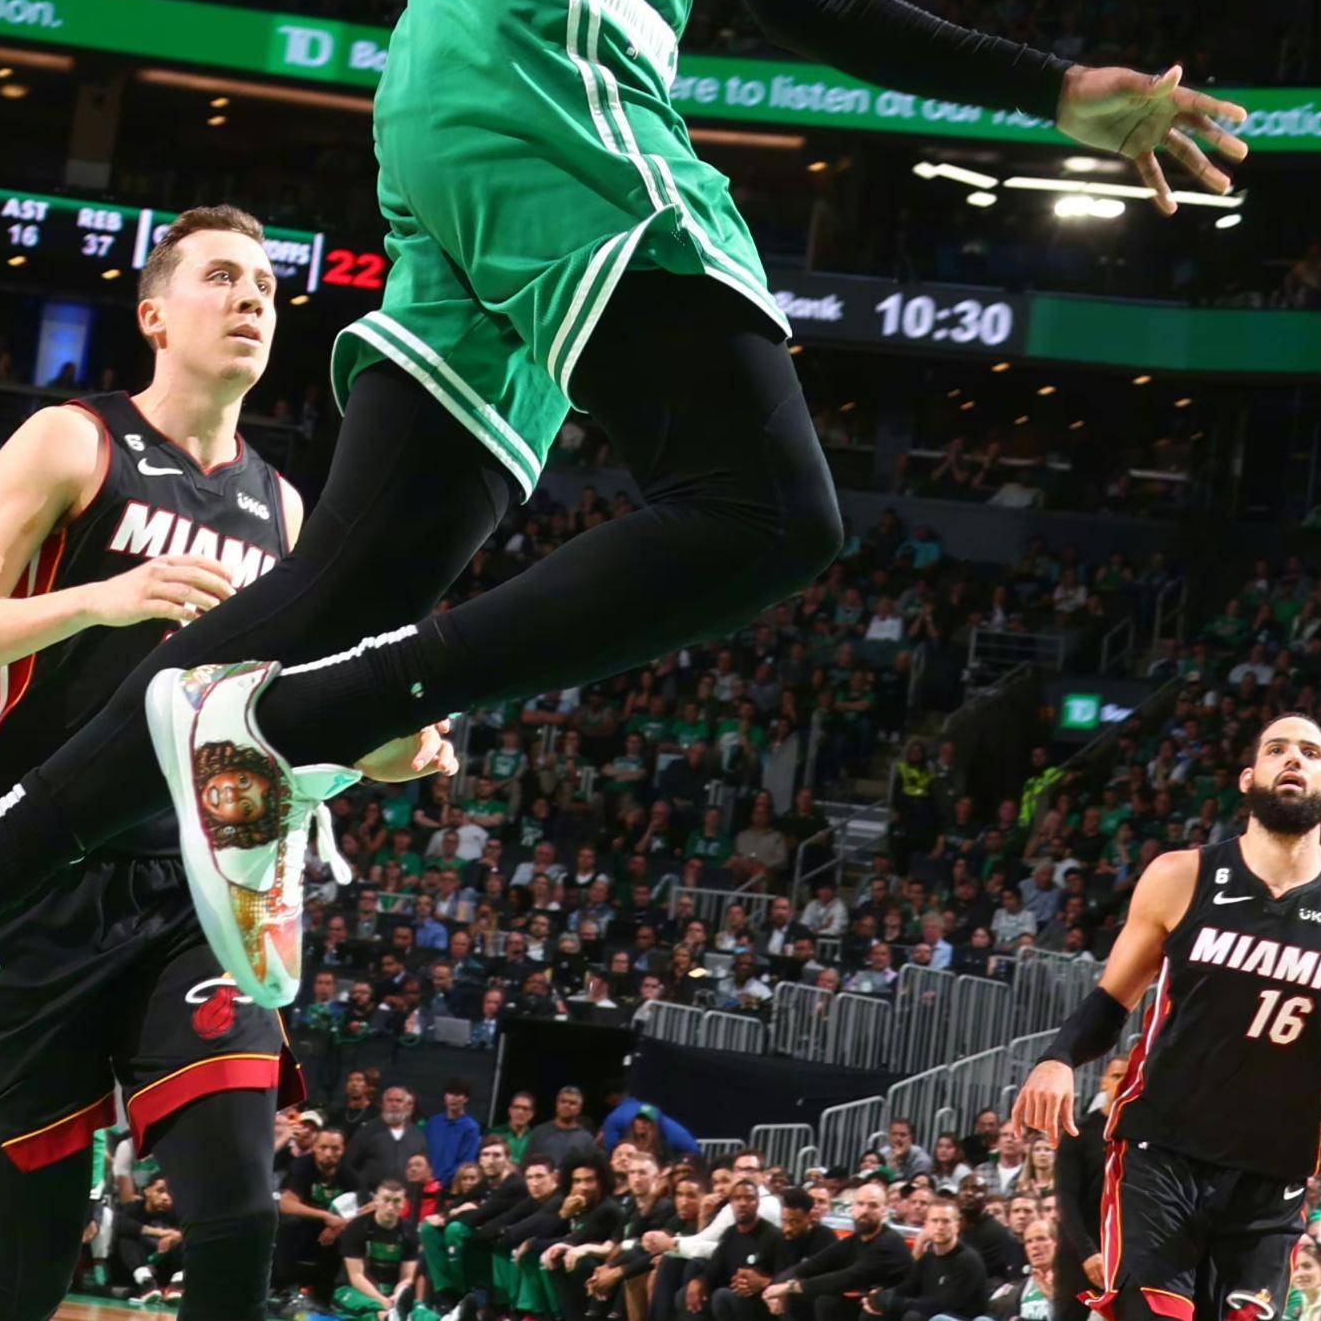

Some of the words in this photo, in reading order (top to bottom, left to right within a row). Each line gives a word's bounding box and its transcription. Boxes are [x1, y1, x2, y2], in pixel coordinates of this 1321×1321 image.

[276, 25, 335, 68] TD
[348, 39, 389, 72] Ba
[670, 75, 720, 104] ere
[725, 75, 767, 107] to
[769, 74, 870, 114] listen
[1, 198, 49, 221] AST
[78, 208, 123, 232] REB
[8, 224, 38, 246] 16
[81, 233, 115, 257] 37
[323, 249, 386, 289] 22
[774, 290, 844, 321] Bank
[875, 292, 1013, 346] 10:30
[124, 434, 145, 451] 6
[1215, 867, 1230, 884] 6
[1246, 989, 1315, 1045] 16
